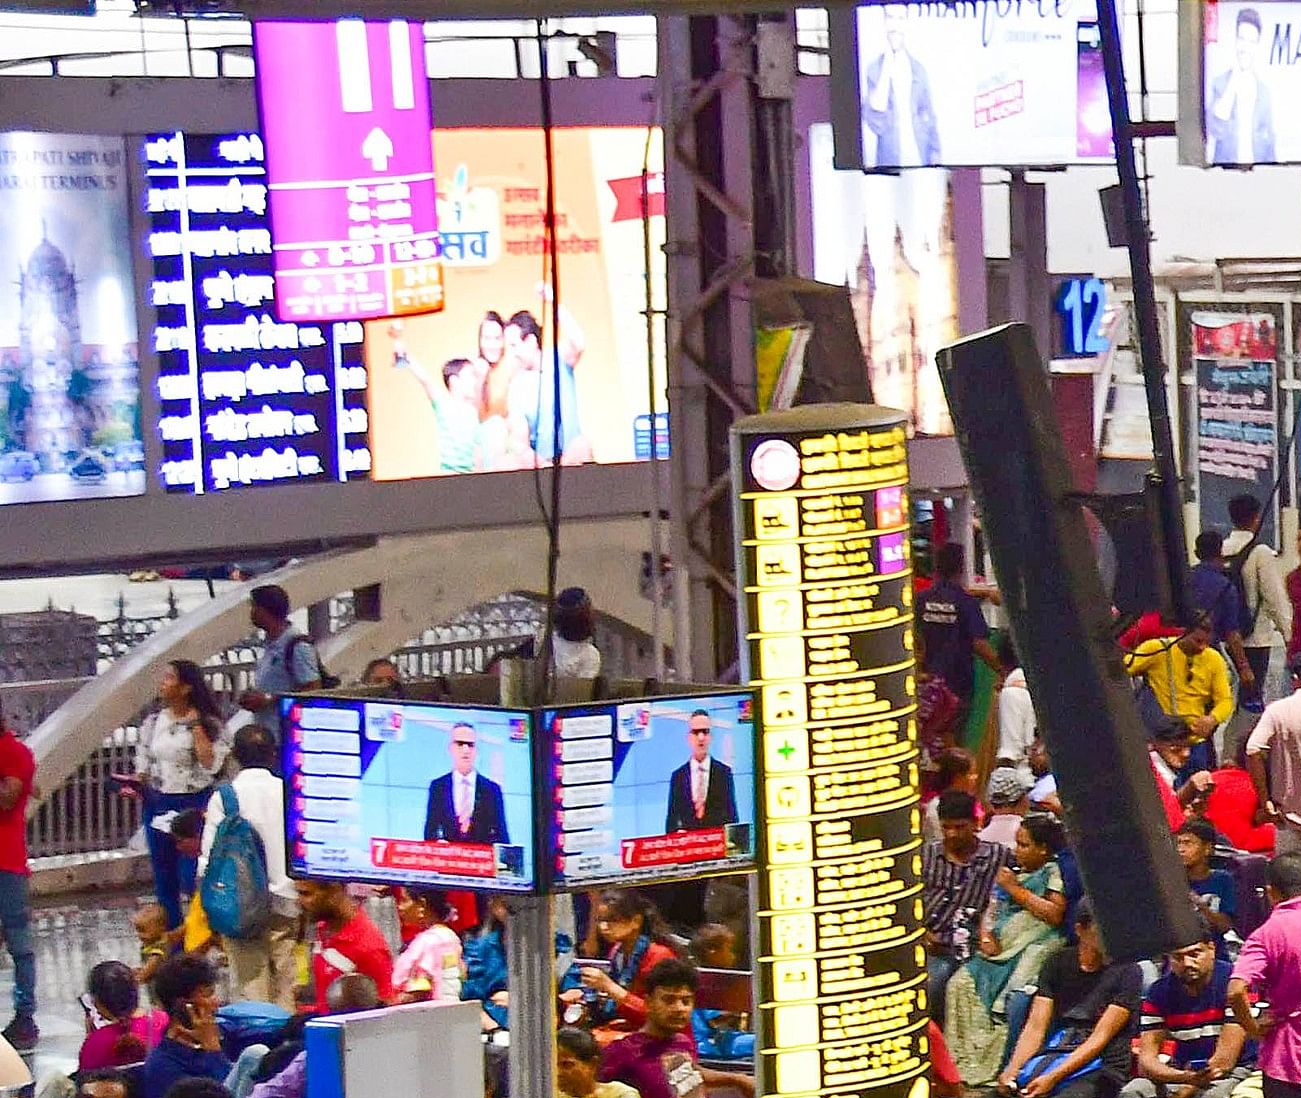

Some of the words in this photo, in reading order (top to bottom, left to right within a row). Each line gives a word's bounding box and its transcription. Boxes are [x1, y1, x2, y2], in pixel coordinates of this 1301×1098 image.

[1064, 278, 1109, 353] 12
[373, 840, 387, 863] 7
[622, 841, 636, 865] 7
